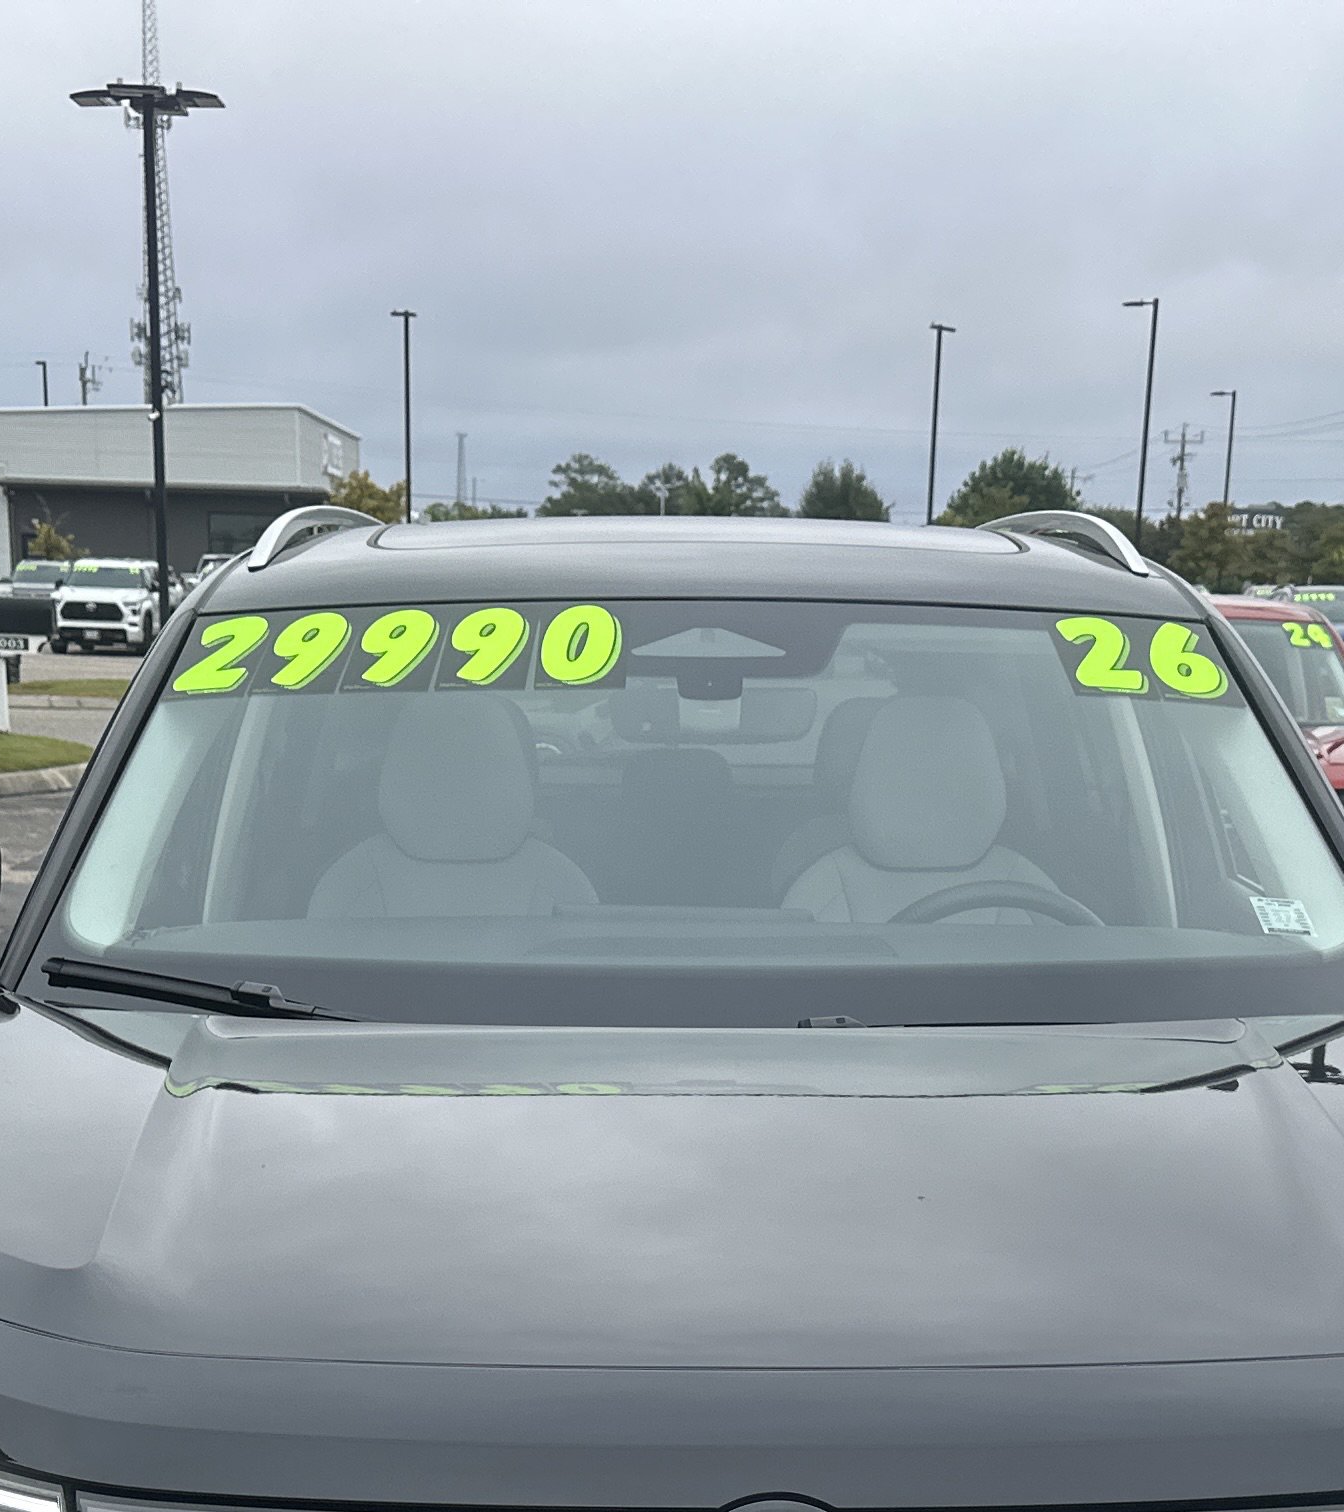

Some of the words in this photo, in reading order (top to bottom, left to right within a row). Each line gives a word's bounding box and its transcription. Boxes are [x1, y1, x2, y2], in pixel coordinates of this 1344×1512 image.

[1252, 513, 1284, 530] CITY
[172, 604, 623, 694] 29990
[1055, 616, 1229, 699] 26
